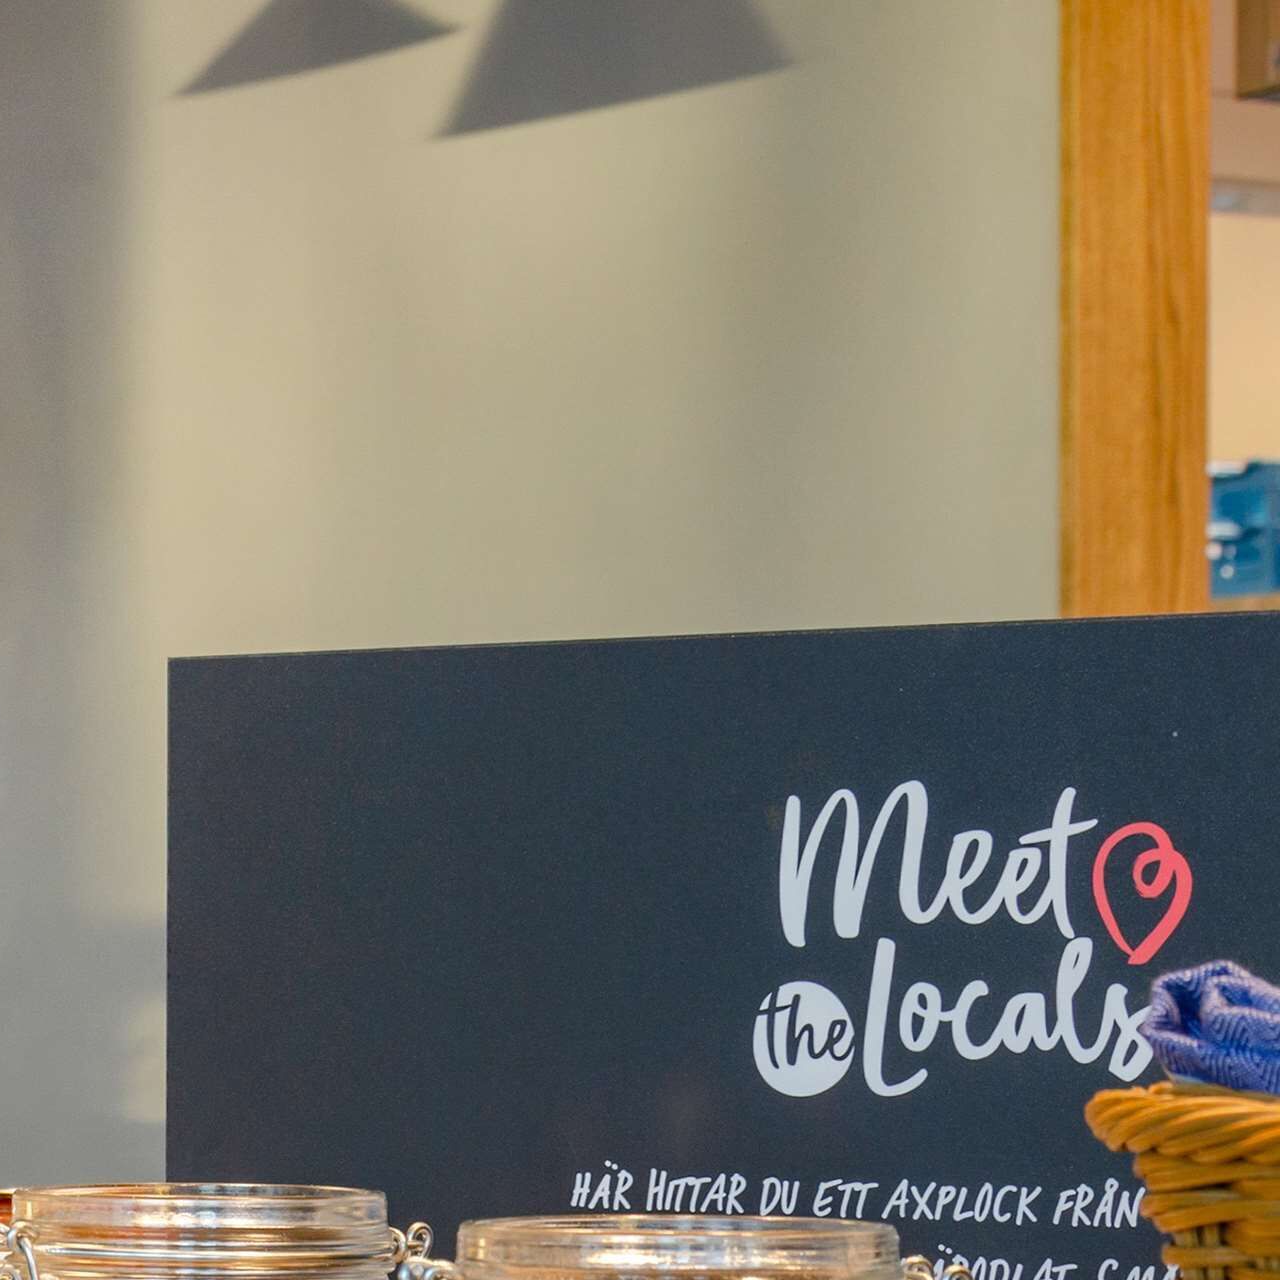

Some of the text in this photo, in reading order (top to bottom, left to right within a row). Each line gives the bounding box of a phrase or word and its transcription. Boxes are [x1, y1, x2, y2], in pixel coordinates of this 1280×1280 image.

[779, 780, 1098, 947] Meet
[758, 936, 1155, 1098] the Locals
[570, 1160, 1145, 1228] HÄR HITTAR DU ETT AXPLOCK FRÅN
